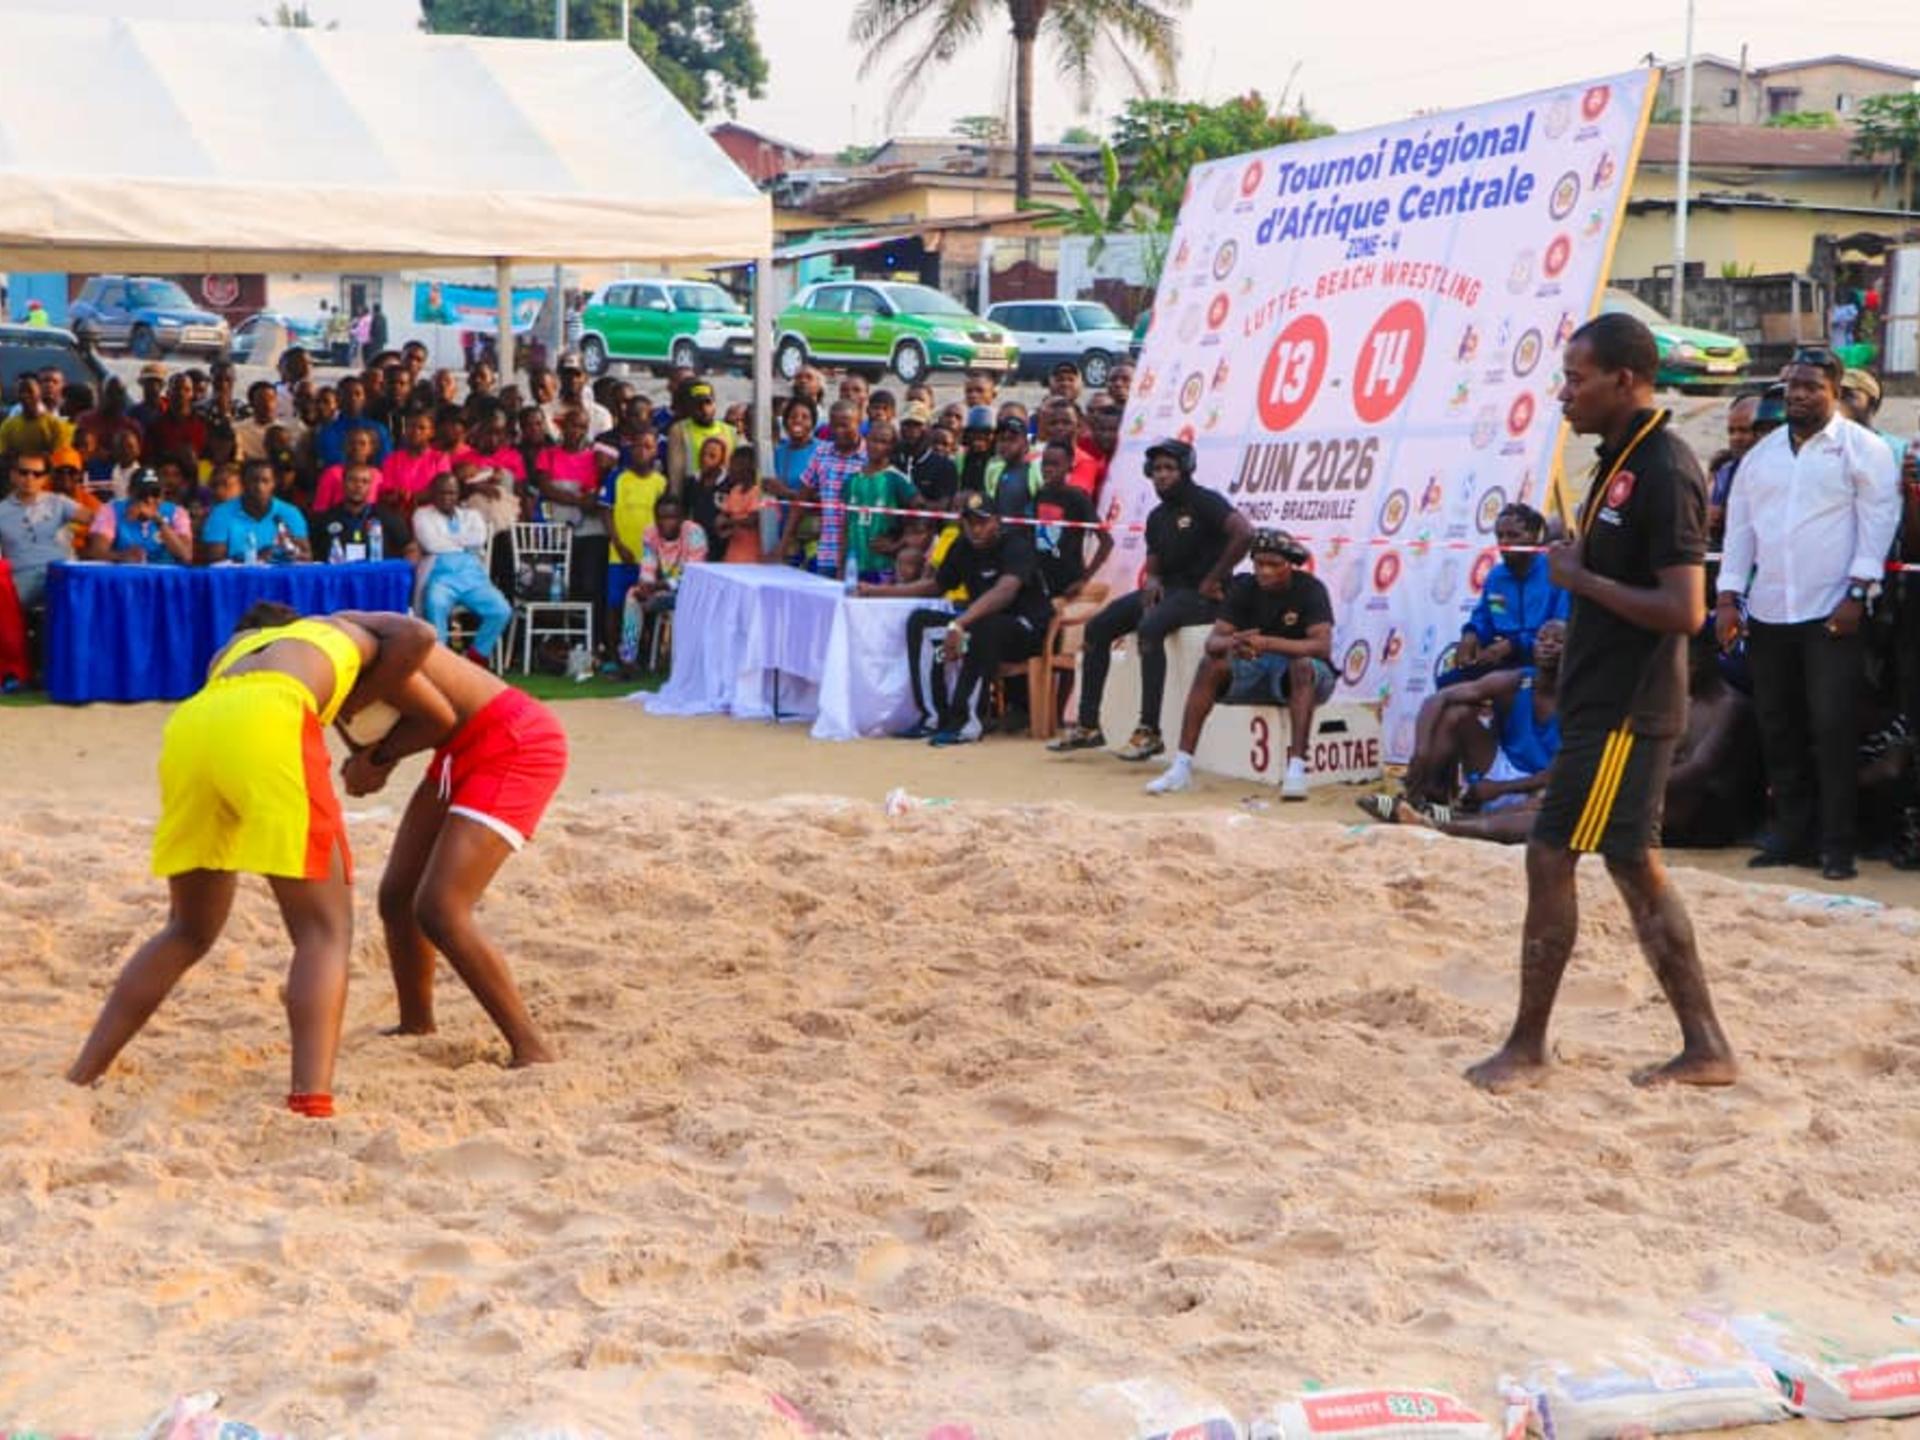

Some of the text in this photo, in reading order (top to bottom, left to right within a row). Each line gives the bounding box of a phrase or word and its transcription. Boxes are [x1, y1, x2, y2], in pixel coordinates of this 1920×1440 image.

[1278, 110, 1535, 197] Tournoi Régional
[1256, 165, 1535, 246] d'Afrique Centrale
[1346, 233, 1380, 260] ZONE
[1315, 261, 1376, 300] BEACH
[1381, 260, 1482, 308] WRESTLING
[1269, 338, 1316, 405] 13
[1363, 329, 1412, 398] 14
[1230, 436, 1380, 494] JUIN 2026
[1281, 499, 1356, 521] BRAZZAVILLE
[1250, 716, 1269, 773] 3
